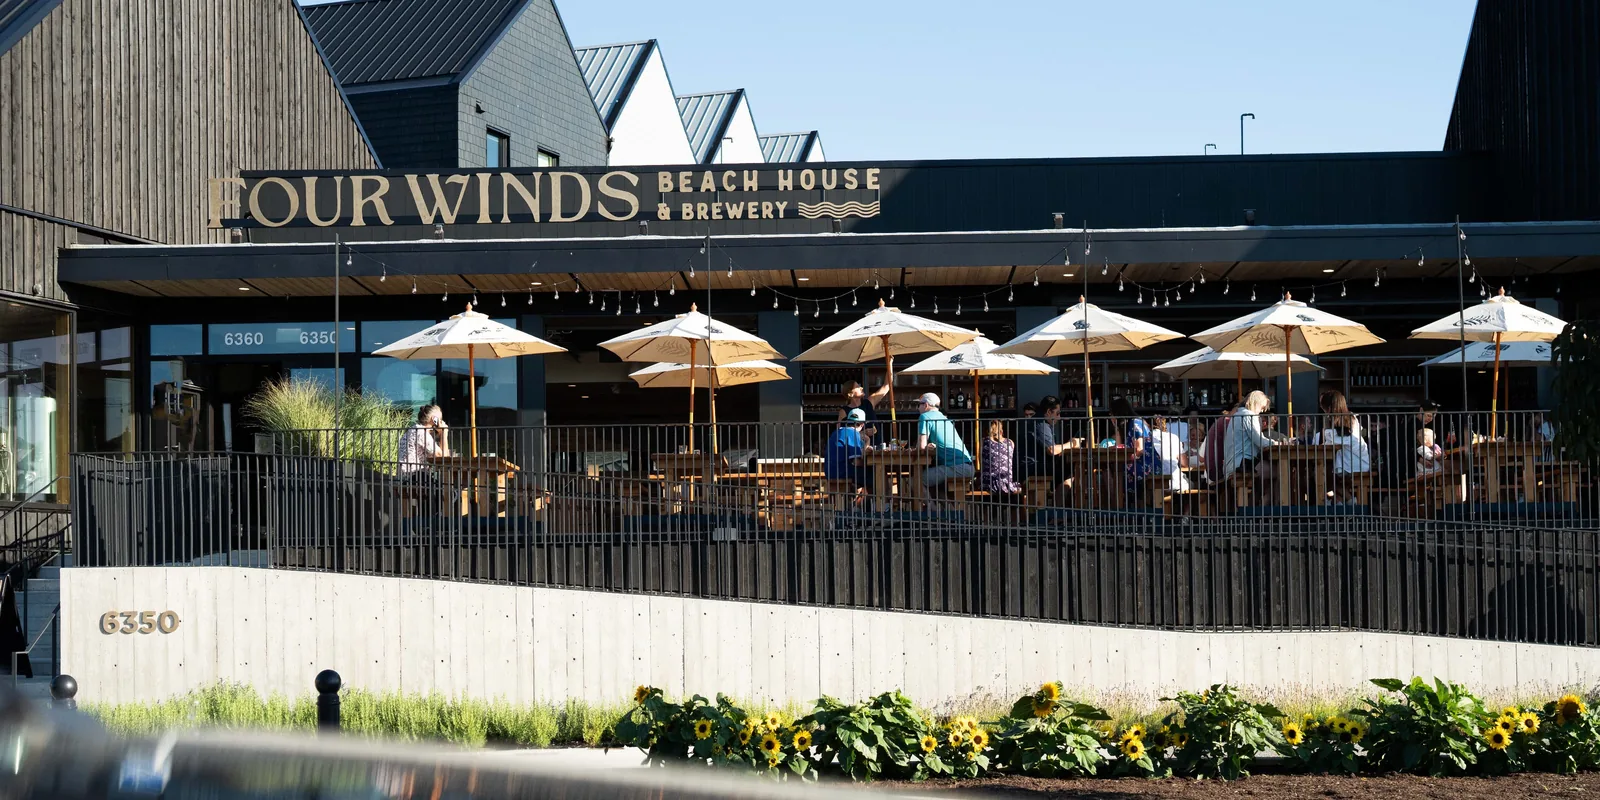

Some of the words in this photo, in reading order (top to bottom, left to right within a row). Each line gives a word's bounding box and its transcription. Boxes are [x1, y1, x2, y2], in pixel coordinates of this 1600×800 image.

[658, 170, 759, 193] BEACH
[778, 167, 881, 191] HOUSE
[207, 175, 395, 229] FOUR
[404, 170, 640, 225] WINDS
[657, 203, 671, 221] &
[682, 200, 788, 220] BREWERY
[224, 332, 264, 346] 6360
[99, 610, 180, 635] 6350
